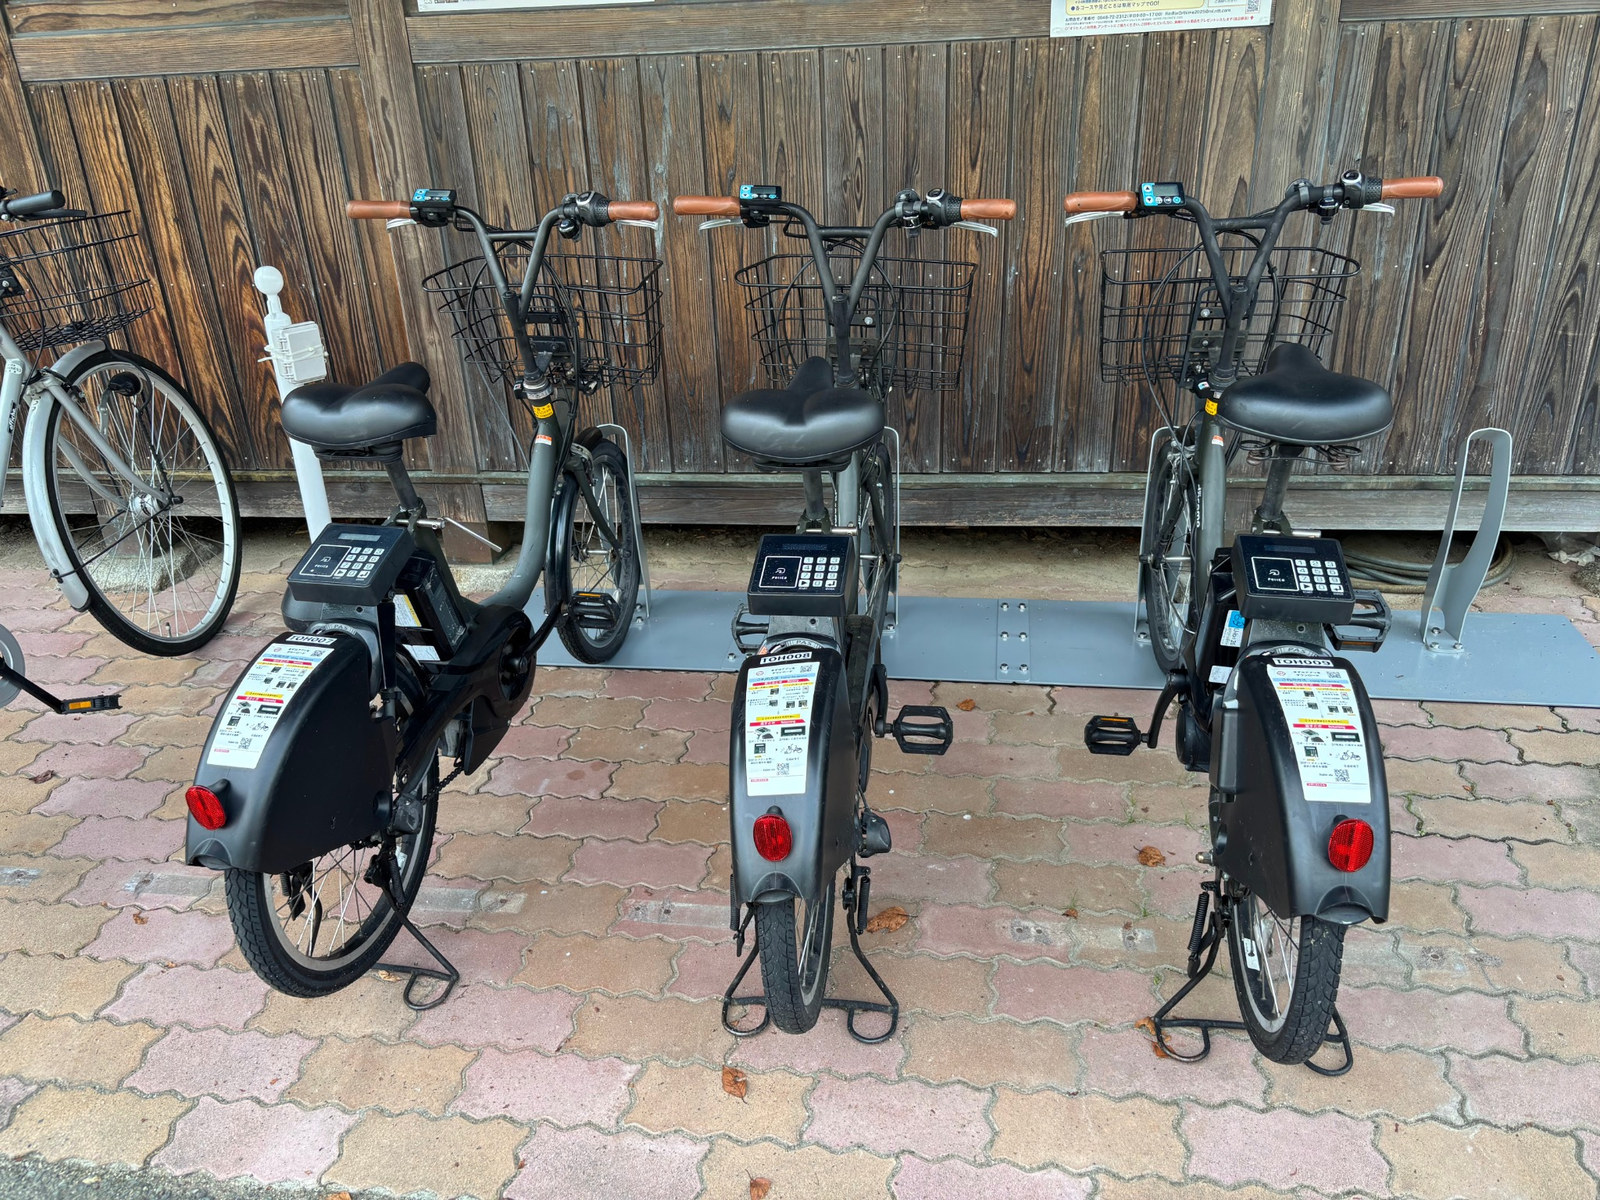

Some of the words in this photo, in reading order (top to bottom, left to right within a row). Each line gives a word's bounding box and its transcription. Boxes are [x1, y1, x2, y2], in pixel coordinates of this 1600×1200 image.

[290, 635, 334, 645] TOH007
[763, 653, 810, 663] TOH008
[1276, 658, 1331, 666] TOH009
